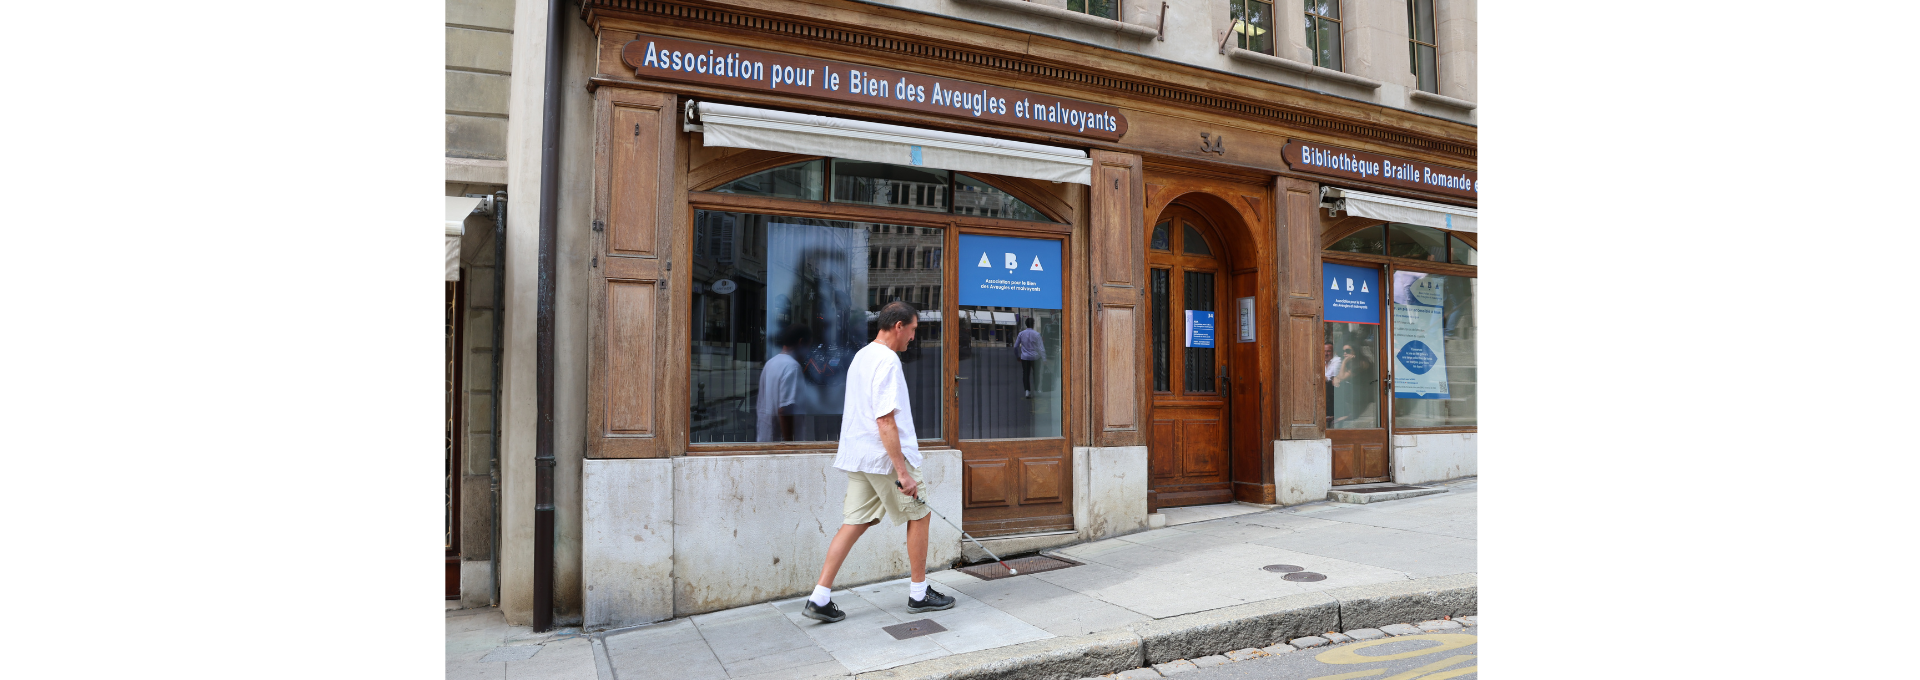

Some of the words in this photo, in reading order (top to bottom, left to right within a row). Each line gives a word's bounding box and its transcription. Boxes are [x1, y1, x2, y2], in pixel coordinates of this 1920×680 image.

[642, 42, 763, 80] Association
[770, 64, 814, 88] pour
[823, 66, 839, 91] le
[850, 70, 888, 98] Bien
[895, 77, 925, 102] des
[931, 82, 1006, 117] Aveugles
[1015, 98, 1029, 118] et
[1034, 102, 1116, 132] malvoyants
[1201, 133, 1224, 156] 34
[1302, 146, 1379, 178] Bibliothèque
[1383, 160, 1420, 182] Braille
[1424, 167, 1471, 191] Romande
